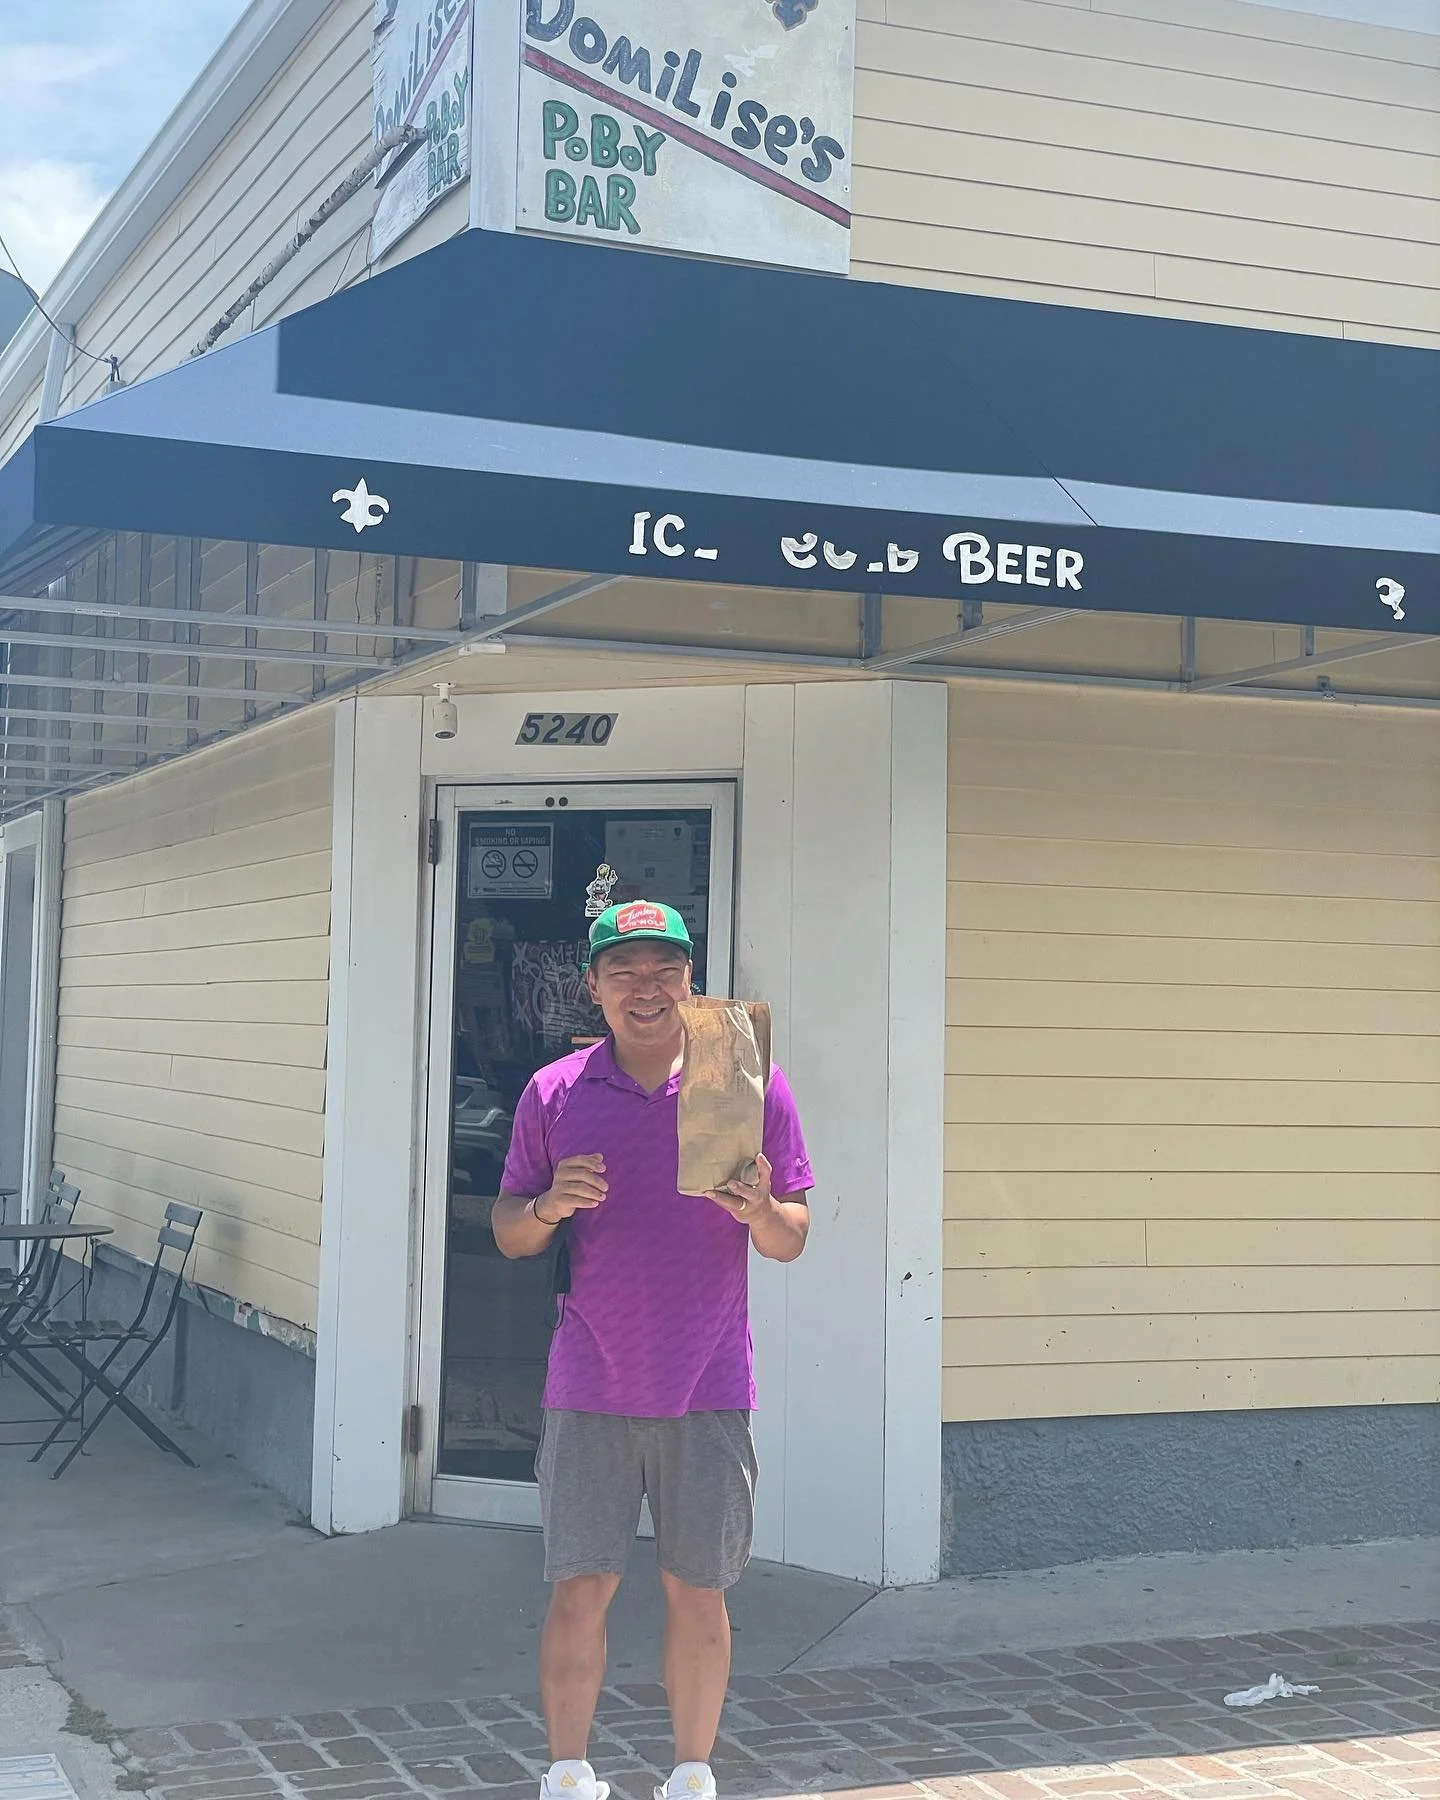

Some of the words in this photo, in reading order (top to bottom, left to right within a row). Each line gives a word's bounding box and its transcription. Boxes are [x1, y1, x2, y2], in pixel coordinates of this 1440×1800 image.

[427, 132, 462, 201] BAR
[544, 168, 642, 235] BAR
[628, 511, 719, 561] IC
[520, 714, 613, 744] 5240
[505, 828, 516, 836] NO
